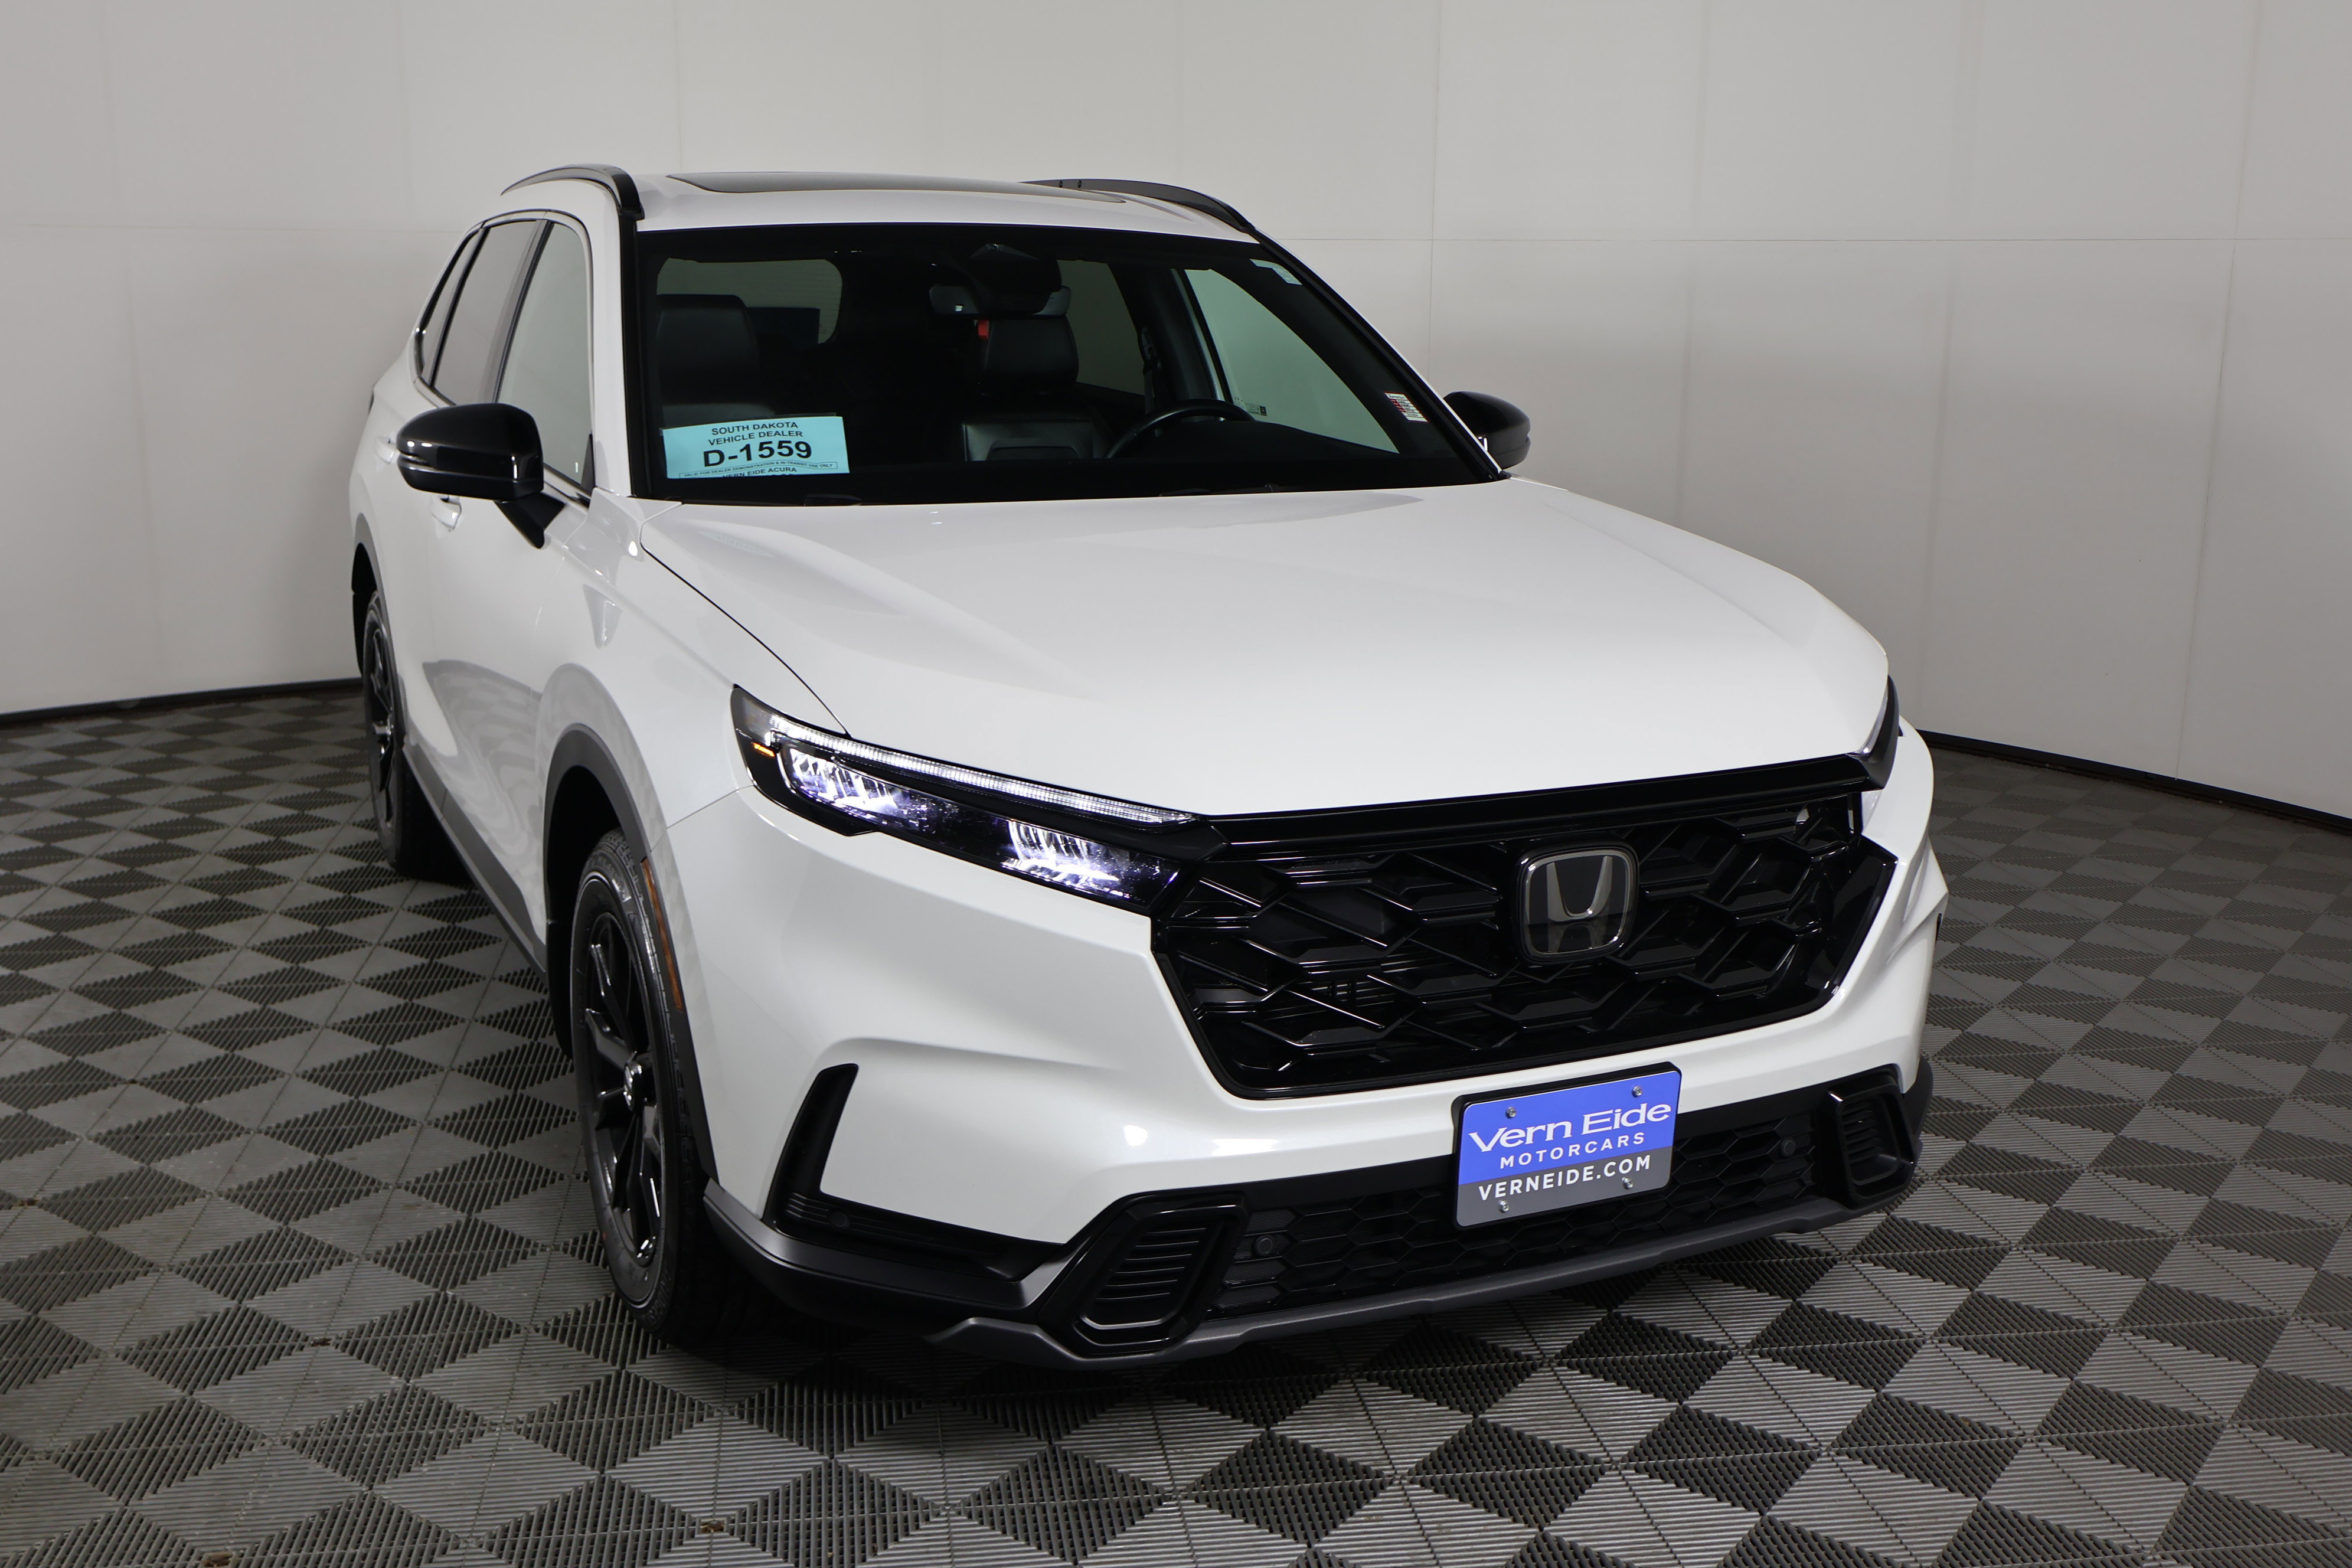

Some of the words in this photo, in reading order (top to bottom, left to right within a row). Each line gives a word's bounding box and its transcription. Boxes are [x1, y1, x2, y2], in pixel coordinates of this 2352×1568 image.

[708, 433, 755, 446] VEHICLE
[711, 425, 749, 435] SOUTH
[753, 422, 798, 430] DAKOTA
[703, 440, 812, 467] D-1559
[733, 462, 775, 471] DEMONSTRATION
[1468, 1120, 1573, 1152] Vern
[1580, 1102, 1672, 1135] Eide
[1500, 1132, 1645, 1170] MOTORCARS
[1478, 1154, 1651, 1201] VERNEIDE.COM
